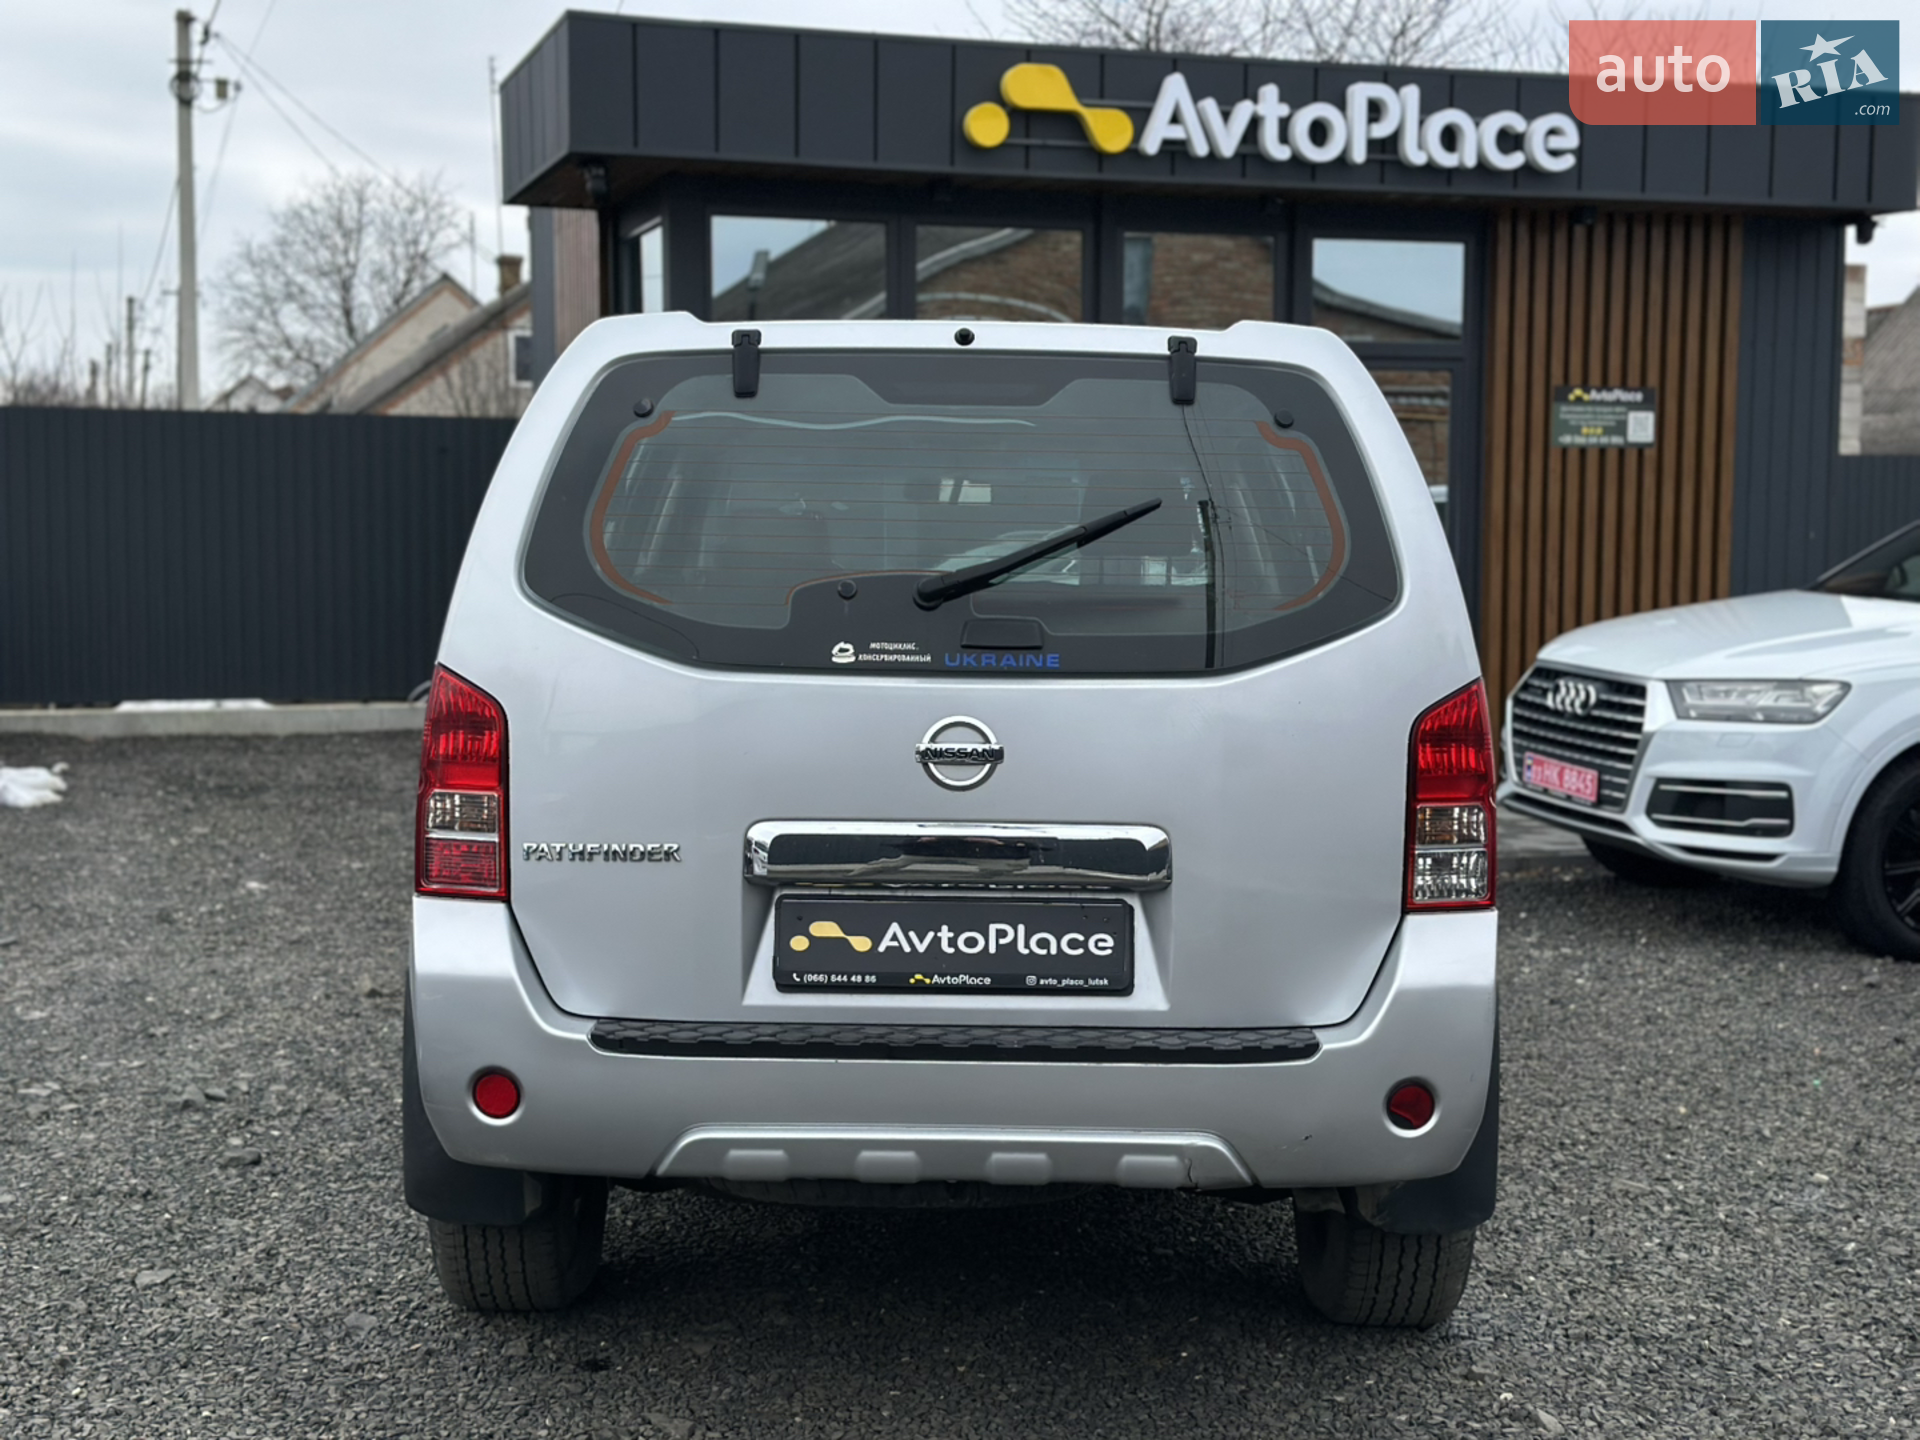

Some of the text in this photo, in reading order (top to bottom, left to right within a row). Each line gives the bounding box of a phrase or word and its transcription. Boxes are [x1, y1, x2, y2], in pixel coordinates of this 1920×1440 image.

[1138, 71, 1581, 173] AvtoPlace
[944, 653, 1060, 668] UKRAINE
[924, 747, 995, 760] NISSAN
[522, 842, 682, 862] PATHFINDER
[877, 921, 1115, 957] AvtoPlace
[932, 973, 991, 985] AvtoPlace
